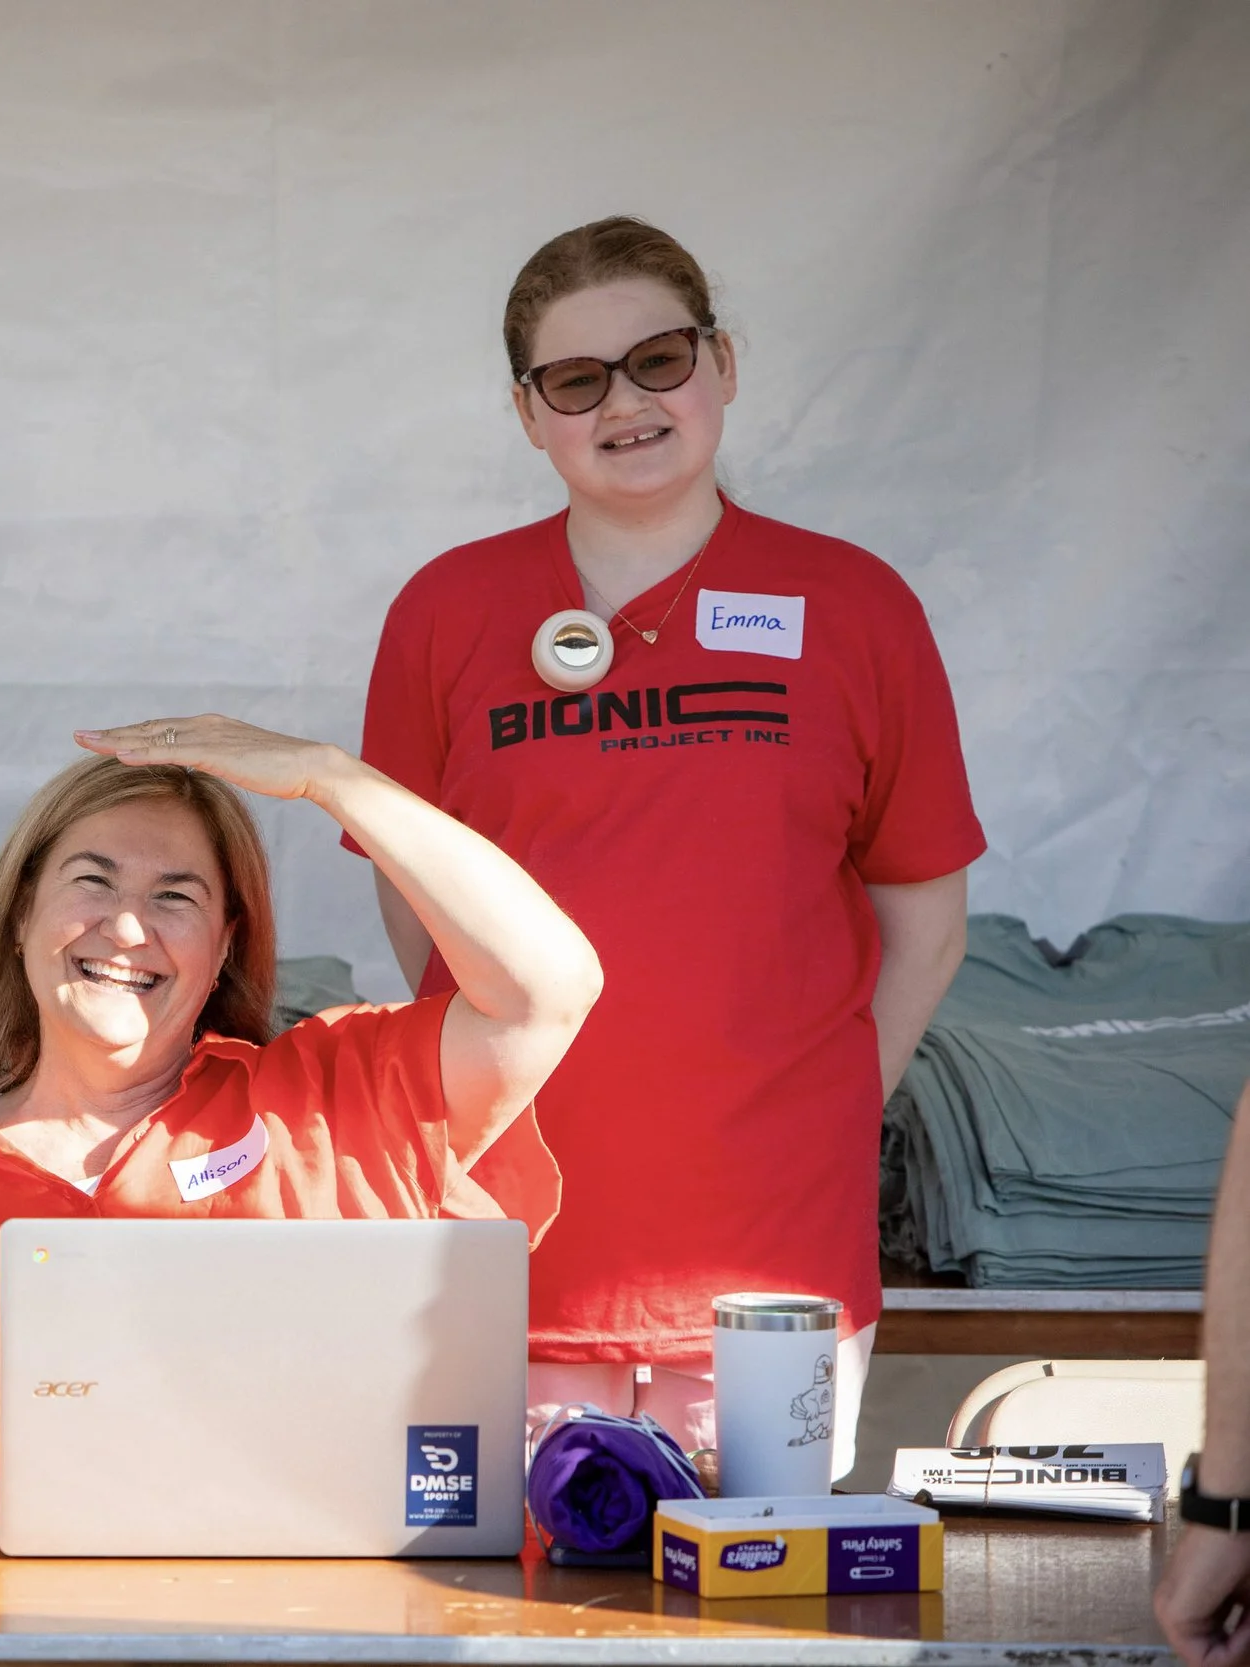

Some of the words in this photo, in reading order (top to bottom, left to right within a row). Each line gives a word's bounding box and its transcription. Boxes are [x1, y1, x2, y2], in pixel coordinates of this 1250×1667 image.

[711, 606, 787, 632] Emma
[488, 680, 789, 751] BIONIC
[600, 729, 734, 754] PROJECT
[745, 729, 790, 746] INC
[187, 1154, 248, 1190] Allison
[33, 1380, 99, 1397] acer
[410, 1474, 473, 1492] DMSE
[954, 1468, 1127, 1485] BIONIC
[423, 1492, 460, 1501] SPORTS
[841, 1538, 866, 1552] Pins
[866, 1536, 903, 1552] Safety
